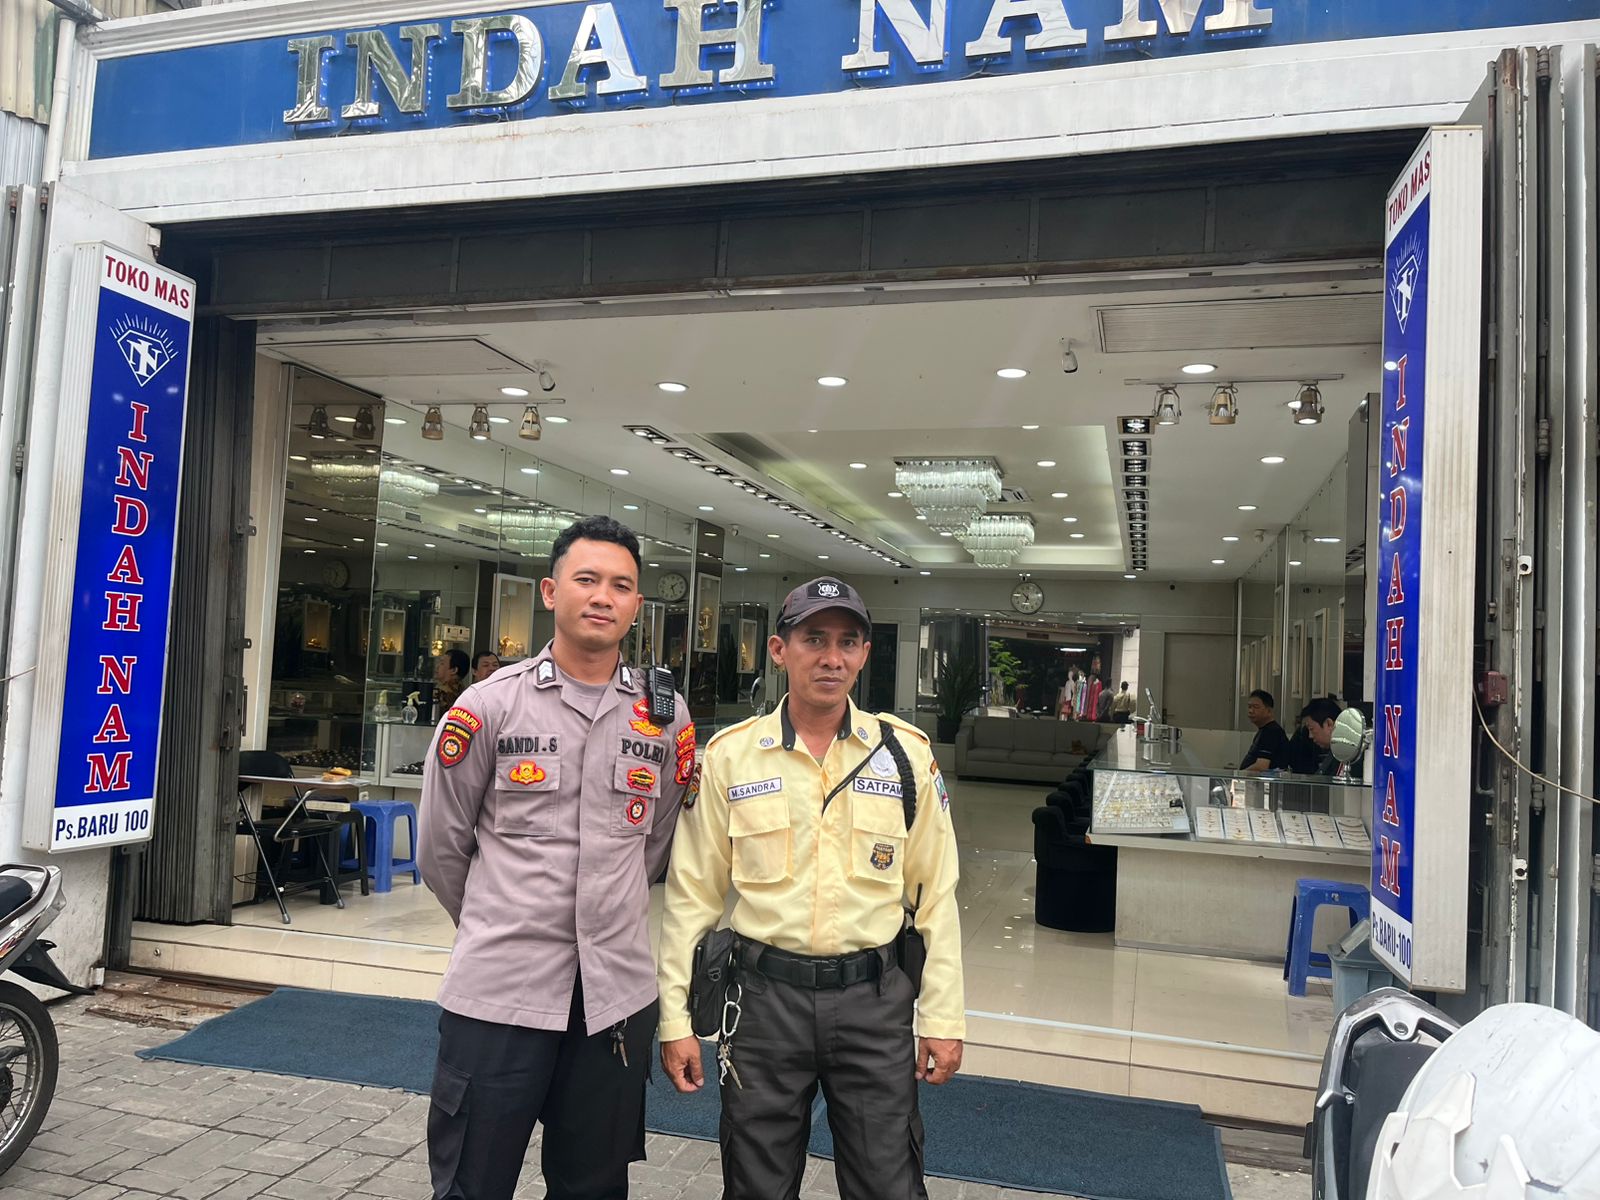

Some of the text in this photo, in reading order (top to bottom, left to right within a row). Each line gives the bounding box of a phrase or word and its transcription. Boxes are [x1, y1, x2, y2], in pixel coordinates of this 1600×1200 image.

[283, 0, 776, 124] INDAH
[1389, 150, 1430, 231] TOKO MAS
[104, 255, 190, 309] TOKO MAS
[84, 401, 154, 794] INDAH NAM
[1379, 354, 1410, 898] INDAH NAM
[124, 809, 149, 832] 100
